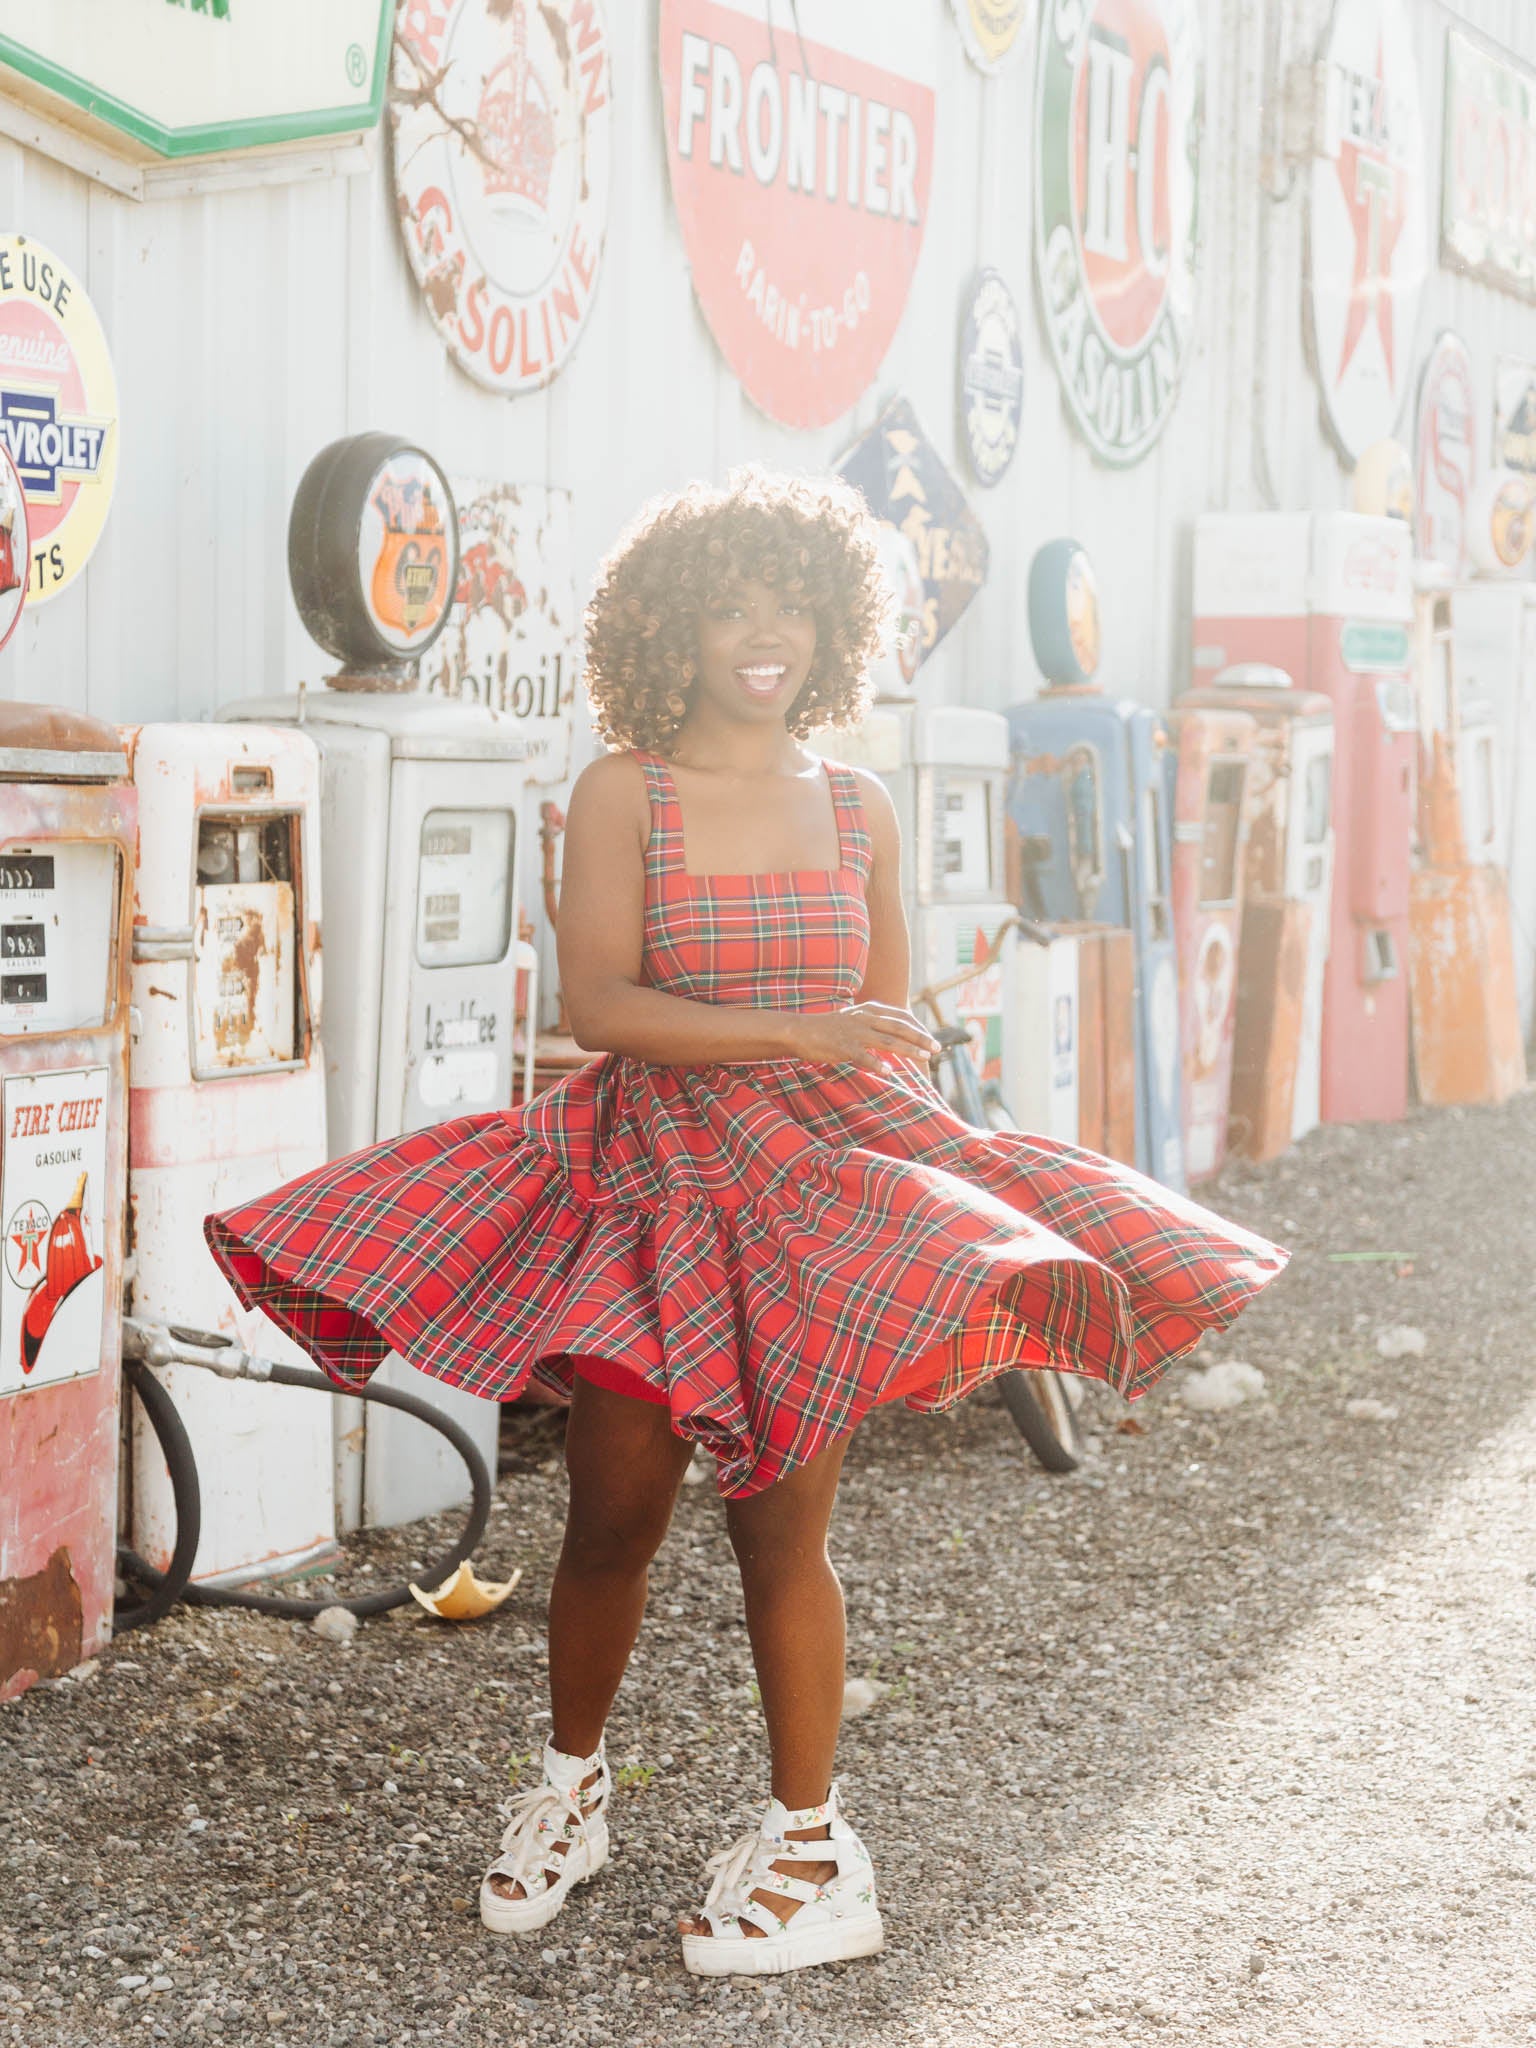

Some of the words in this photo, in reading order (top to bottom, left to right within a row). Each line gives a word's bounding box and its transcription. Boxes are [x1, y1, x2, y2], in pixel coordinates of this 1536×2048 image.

[678, 30, 919, 225] FRONTIER
[22, 252, 72, 318] USE
[0, 331, 70, 368] enuine
[0, 419, 101, 468] VROLET
[11, 1103, 53, 1139] FIRE
[58, 1097, 102, 1132] CHIEF
[35, 1147, 82, 1167] GASOLINE
[14, 1216, 49, 1231] TEXACO
